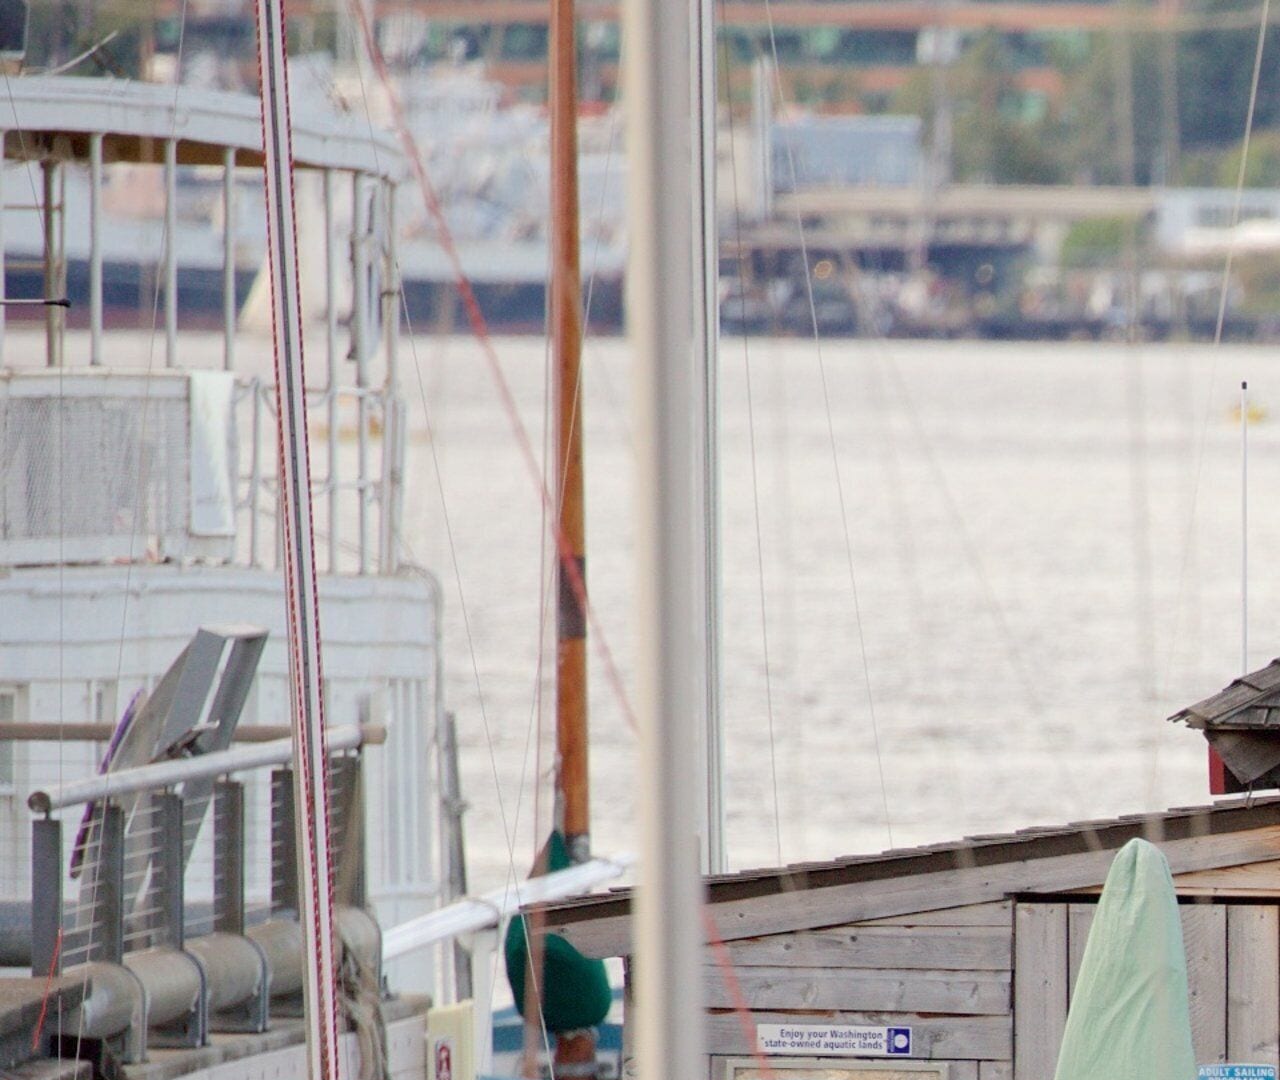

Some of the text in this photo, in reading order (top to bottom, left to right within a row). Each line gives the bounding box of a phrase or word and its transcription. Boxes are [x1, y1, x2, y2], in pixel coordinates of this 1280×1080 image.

[780, 1028, 804, 1039] Enjoy
[807, 1031, 828, 1040] your
[829, 1030, 883, 1041] Washington
[764, 1039, 821, 1049] state-owned
[823, 1040, 853, 1051] aquatic
[858, 1039, 883, 1050] lands
[1199, 1067, 1275, 1077] ADULT SAILING
